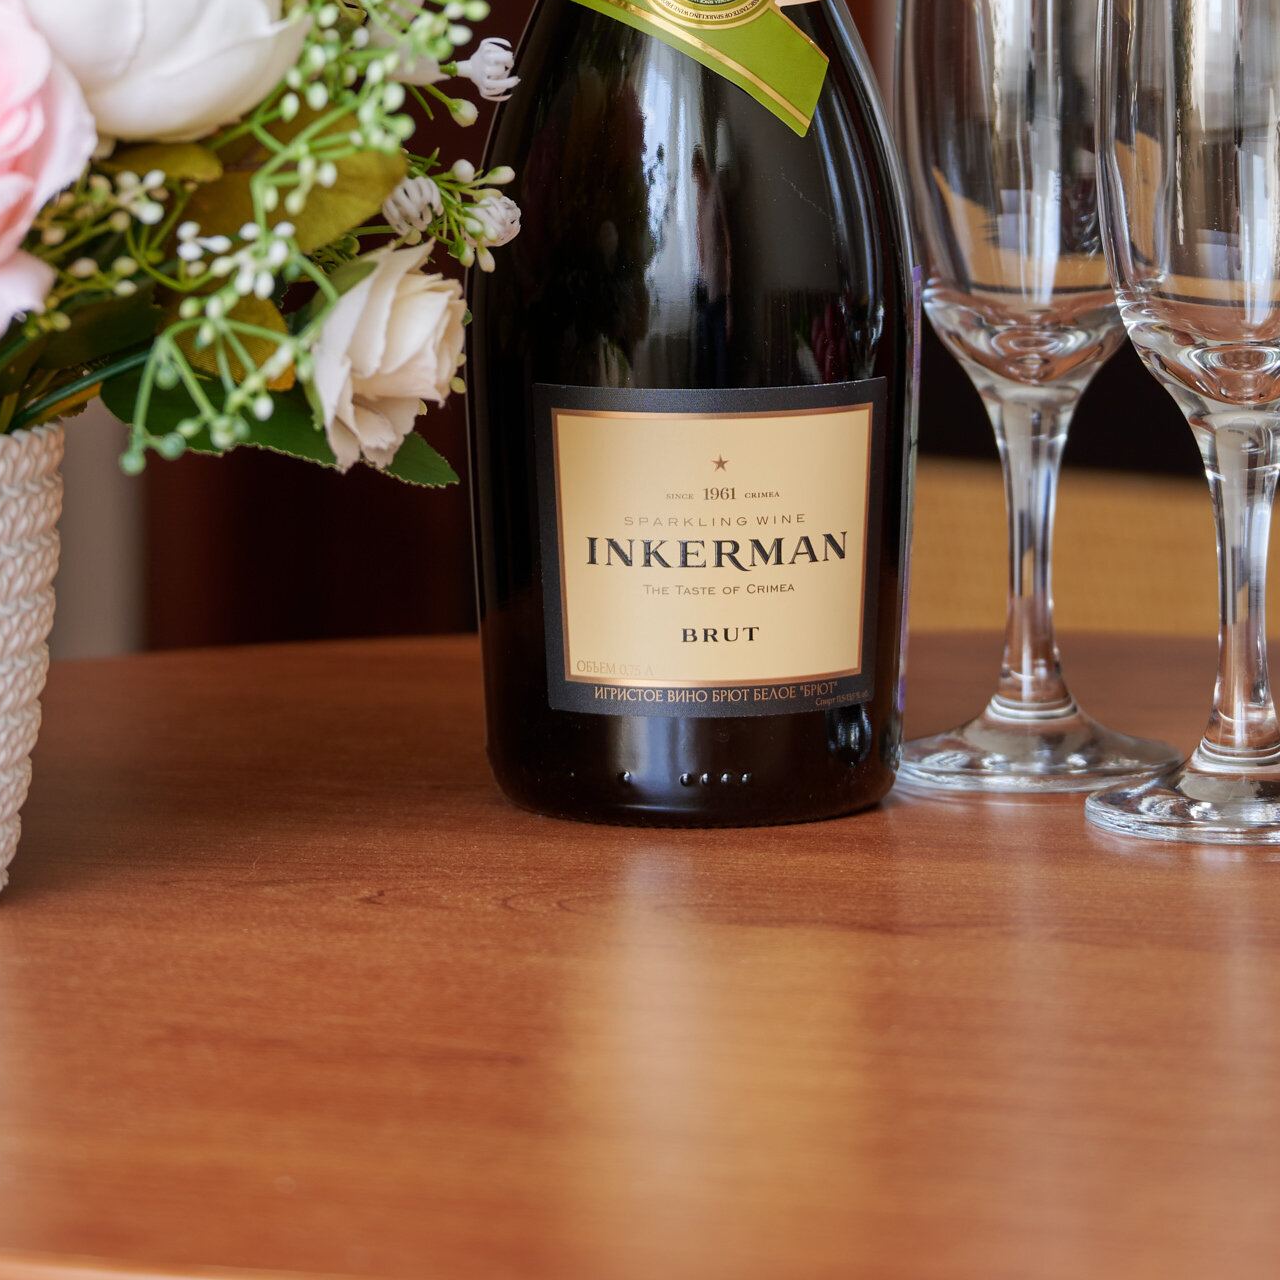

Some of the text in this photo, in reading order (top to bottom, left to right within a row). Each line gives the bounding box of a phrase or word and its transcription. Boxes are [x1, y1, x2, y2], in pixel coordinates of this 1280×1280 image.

[703, 487, 736, 501] 1961
[744, 491, 780, 499] CRIMEA
[624, 513, 806, 527] SPARKLING WINE
[586, 531, 848, 572] INKERMAN
[681, 626, 760, 643] BRUT
[576, 660, 616, 675] ОБЪЕМ
[594, 686, 663, 703] ИГРИСТОЕ
[667, 688, 708, 704] ВИНО
[712, 687, 750, 703] БРЮТ
[753, 685, 797, 701] БЕЛОЕ
[799, 681, 838, 697] "БРЮТ"
